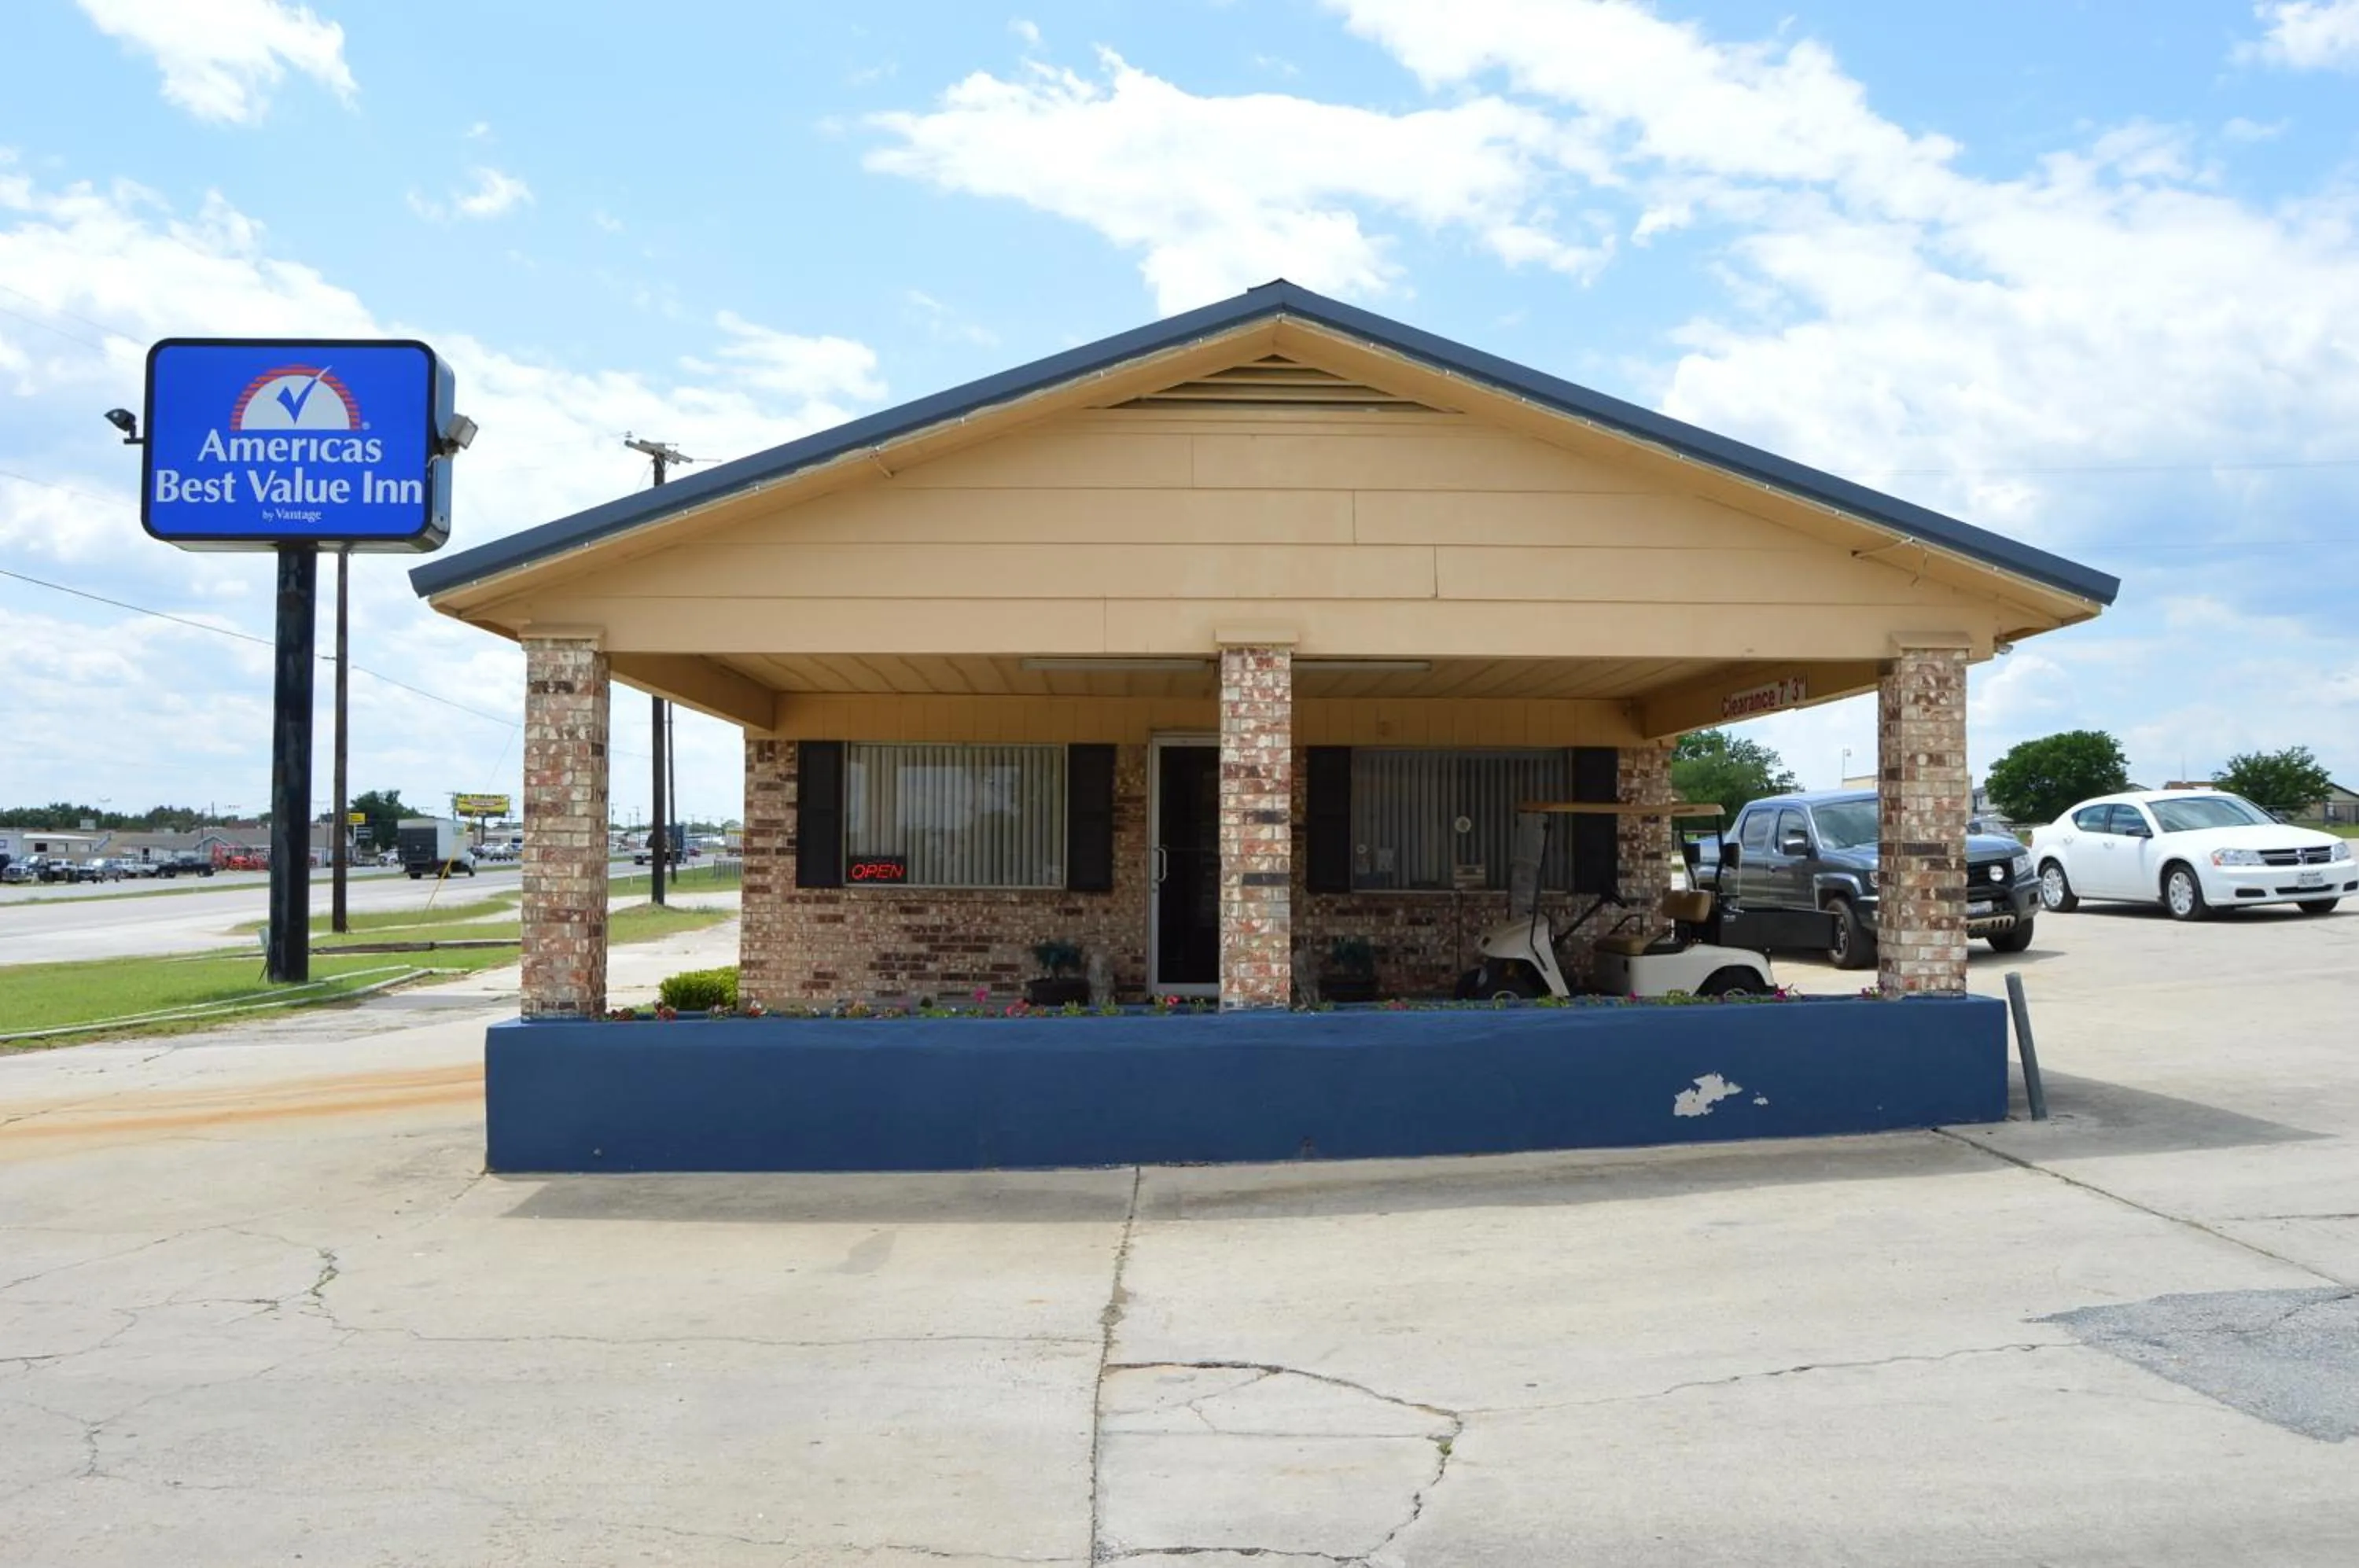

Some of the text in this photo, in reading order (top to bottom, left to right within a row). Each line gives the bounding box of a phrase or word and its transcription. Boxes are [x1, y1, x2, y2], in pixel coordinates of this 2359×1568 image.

[197, 429, 383, 463] Americas
[155, 467, 422, 504] Best Value Inn
[263, 508, 322, 523] by Vantage
[1721, 689, 1776, 717] Clearance
[852, 863, 903, 880] OPEN
